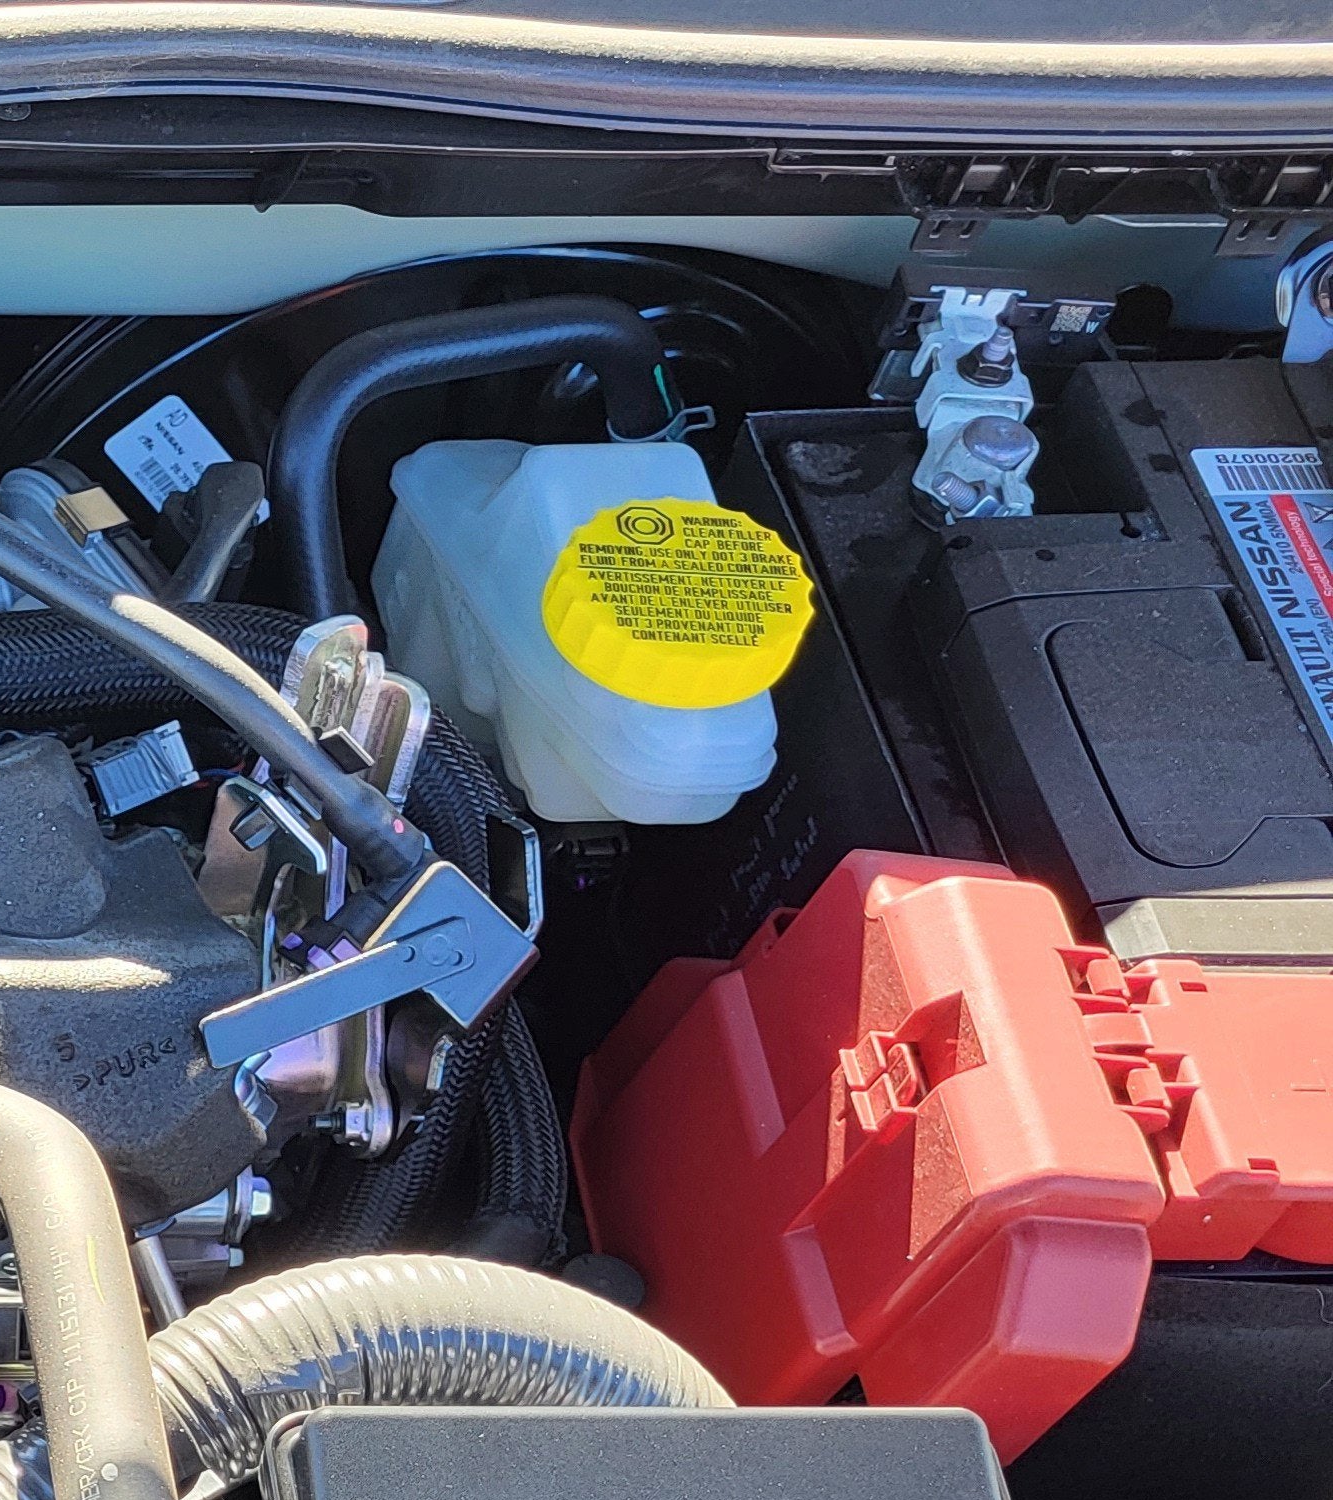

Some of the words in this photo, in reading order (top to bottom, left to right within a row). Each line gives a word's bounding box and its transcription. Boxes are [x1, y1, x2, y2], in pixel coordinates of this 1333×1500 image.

[680, 515, 742, 528] WARNING:
[683, 527, 725, 538] CLEAN
[727, 530, 772, 541] FILLER
[684, 538, 710, 549] CAP
[716, 540, 764, 552] BEFORE
[580, 554, 616, 567] FLUID
[621, 557, 656, 569] FROM
[661, 559, 669, 569] A
[673, 560, 725, 573] SEALED
[727, 563, 801, 577] CONTAINER.
[648, 548, 672, 559] USE
[675, 549, 708, 561] ONLY
[712, 551, 735, 562] DOT
[738, 552, 748, 563] 3
[751, 553, 793, 565] BRAKE
[1223, 501, 1307, 618] NISSAN
[1275, 541, 1305, 575] 24410
[604, 581, 660, 595] BOUCHON
[664, 585, 681, 596] DE
[683, 586, 774, 602] REMPLISSAGE
[701, 577, 767, 590] NETTOYER
[771, 580, 786, 592] LE
[590, 592, 634, 605] AVANT
[639, 595, 655, 606] DE
[735, 601, 793, 615] UTILISER
[614, 603, 690, 618] SEULEMENT
[694, 609, 712, 621] DU
[714, 611, 765, 624] LIQUIDE
[616, 616, 640, 628] DOT
[645, 618, 654, 629] 3
[656, 619, 733, 634] PROVENANT
[632, 629, 707, 645] CONTENANT
[711, 633, 760, 647] SCELLÉ
